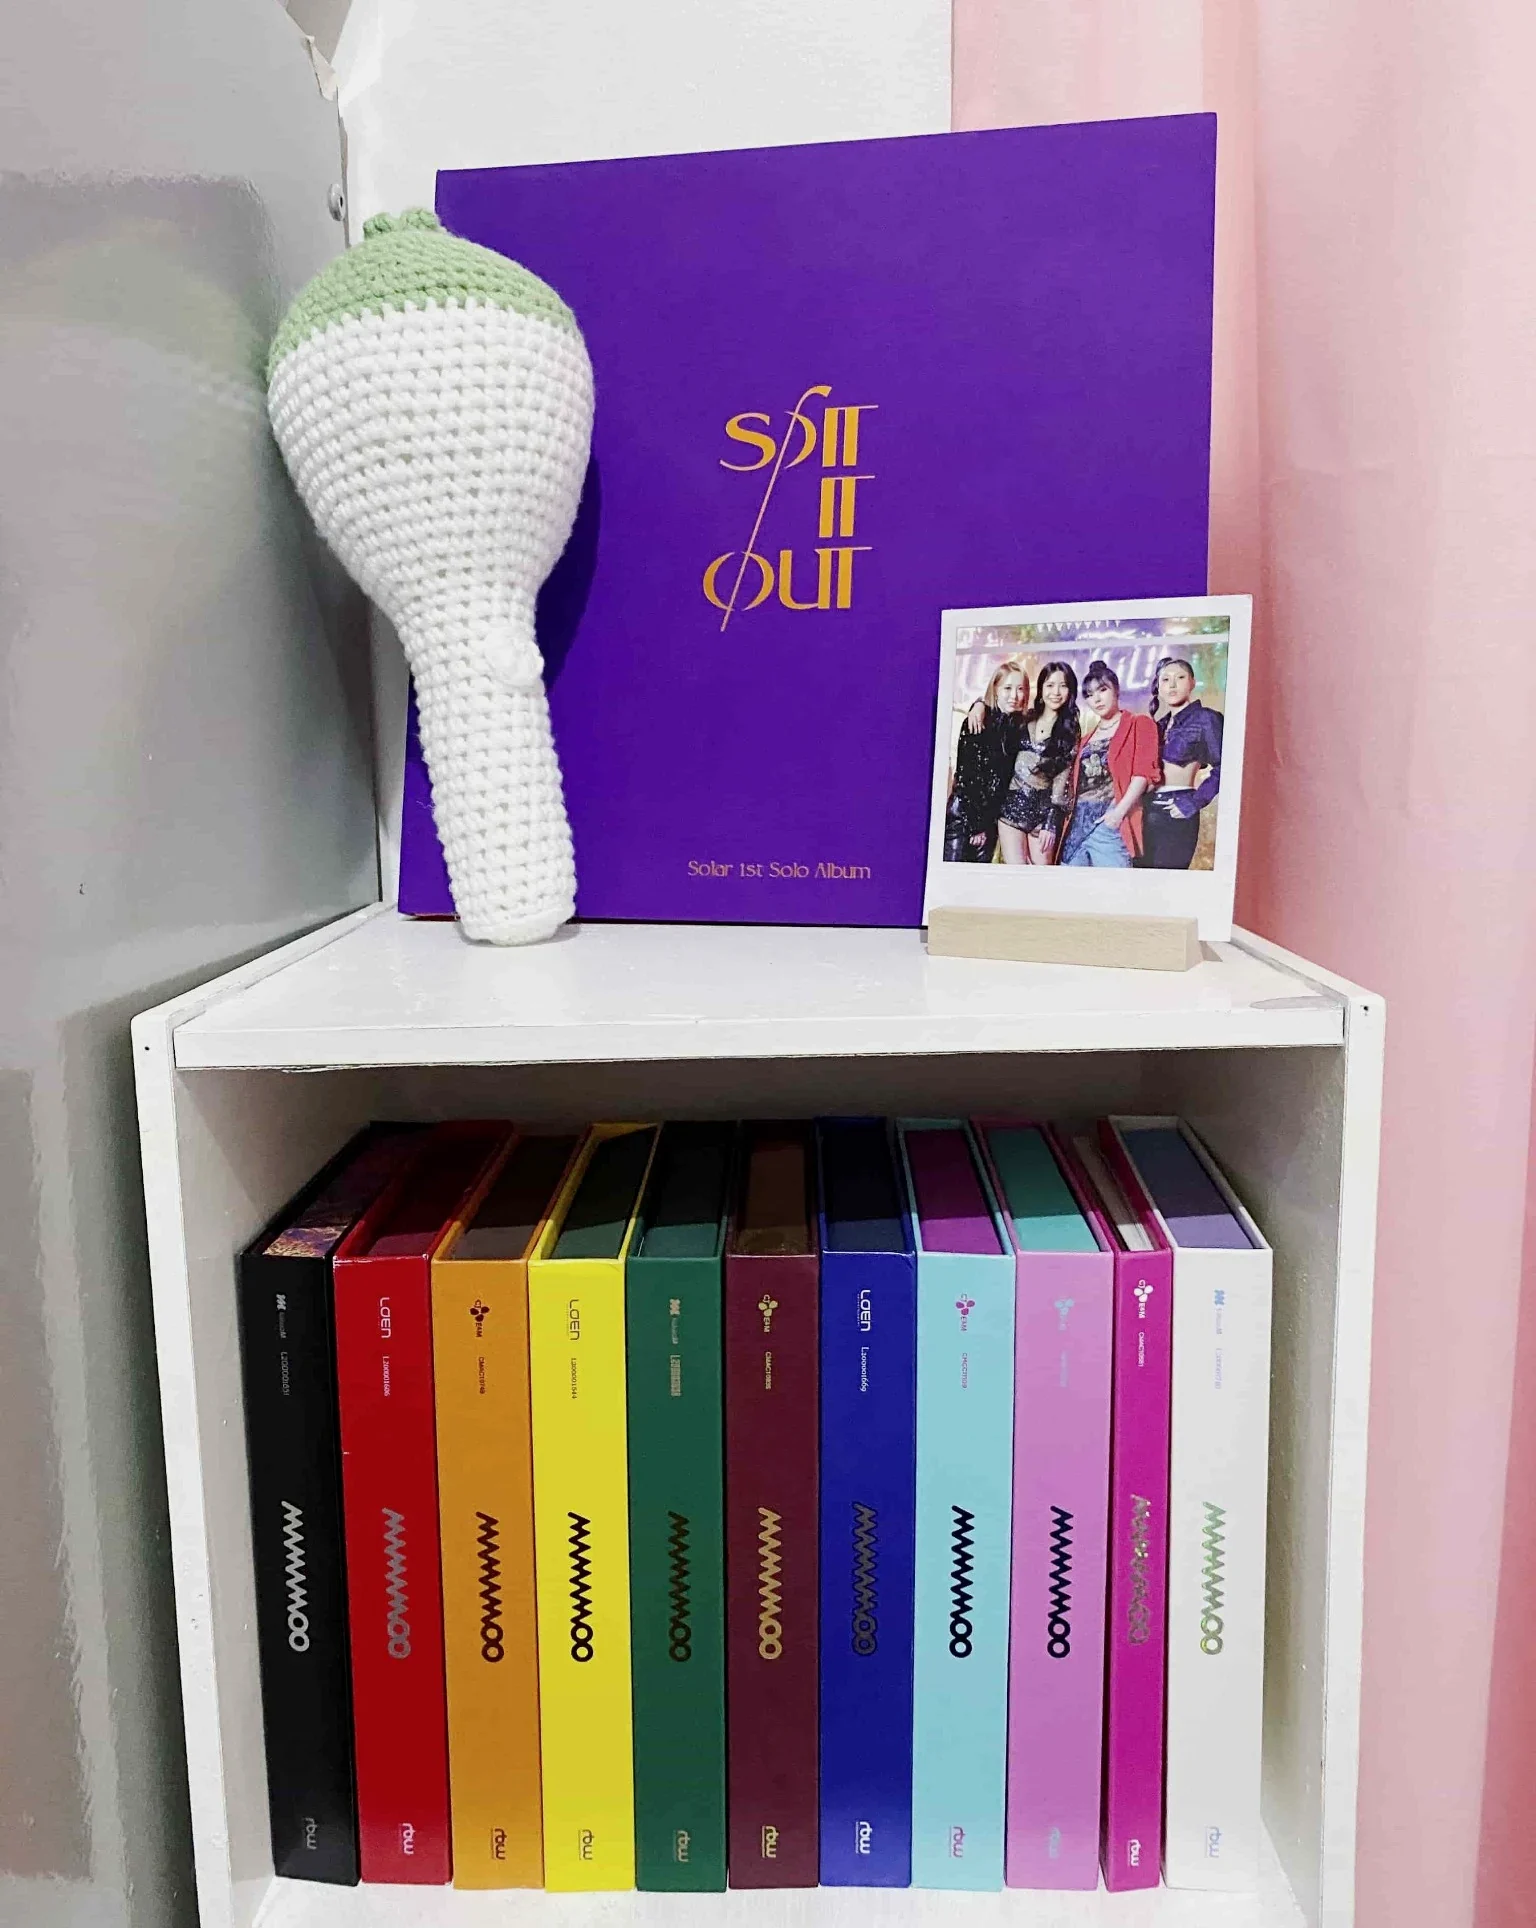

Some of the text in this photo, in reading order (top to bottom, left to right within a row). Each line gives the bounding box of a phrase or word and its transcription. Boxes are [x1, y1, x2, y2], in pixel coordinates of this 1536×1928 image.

[719, 385, 879, 472] SPIT
[818, 475, 875, 538] IT
[703, 546, 873, 611] OUT
[687, 860, 872, 879] Solar 1st Solo Album
[379, 1296, 392, 1339] LOEN
[568, 1299, 580, 1341] LOEN
[860, 1289, 871, 1332] LOEN
[859, 1346, 869, 1392] L200001669
[281, 1500, 310, 1652] MAMAMOO
[381, 1507, 411, 1660] MAMAMOO
[475, 1511, 505, 1663] MAMAMOO
[567, 1511, 594, 1663] MAMAMOO
[667, 1510, 692, 1662] MAMAMOO
[758, 1507, 783, 1660] MAMAMOO
[949, 1504, 975, 1659] MAMAMOO
[1047, 1505, 1074, 1659] MAMAMOO
[304, 1816, 318, 1850] rbw
[402, 1822, 416, 1856] rbw
[493, 1827, 508, 1861] rbw
[581, 1828, 595, 1861] rbw
[676, 1829, 691, 1863] rbw
[765, 1825, 780, 1859] rbw
[859, 1820, 873, 1855] rbw
